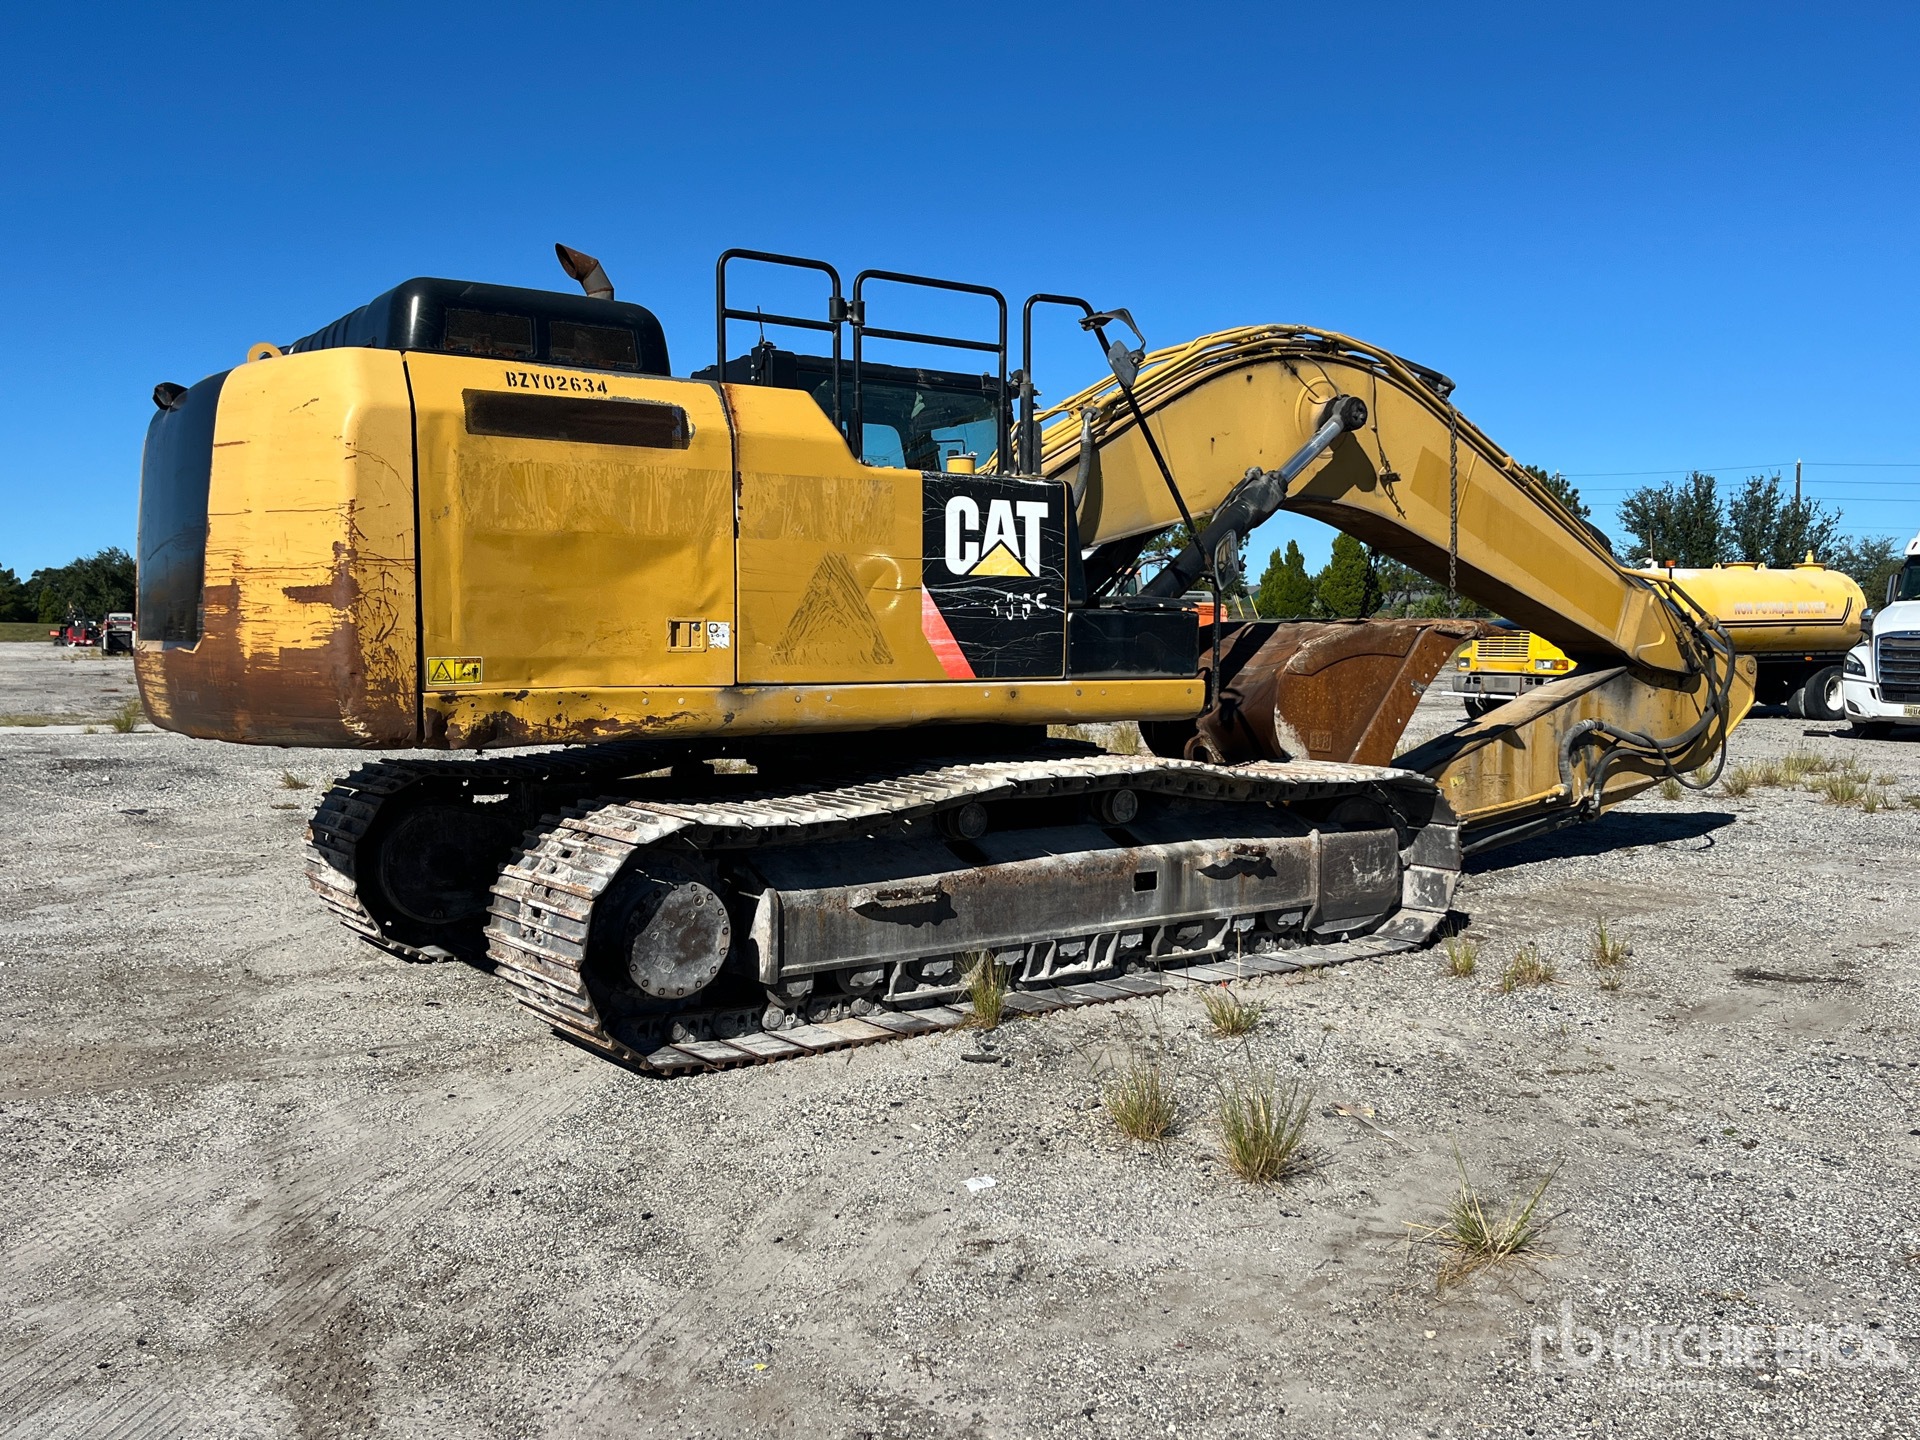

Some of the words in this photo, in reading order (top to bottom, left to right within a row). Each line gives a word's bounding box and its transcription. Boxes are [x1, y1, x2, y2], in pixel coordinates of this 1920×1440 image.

[505, 371, 608, 395] BZY02634
[945, 495, 1049, 577] CAT
[1734, 602, 1753, 615] NON
[1755, 602, 1795, 615] POTABLE
[1797, 601, 1827, 614] WATER
